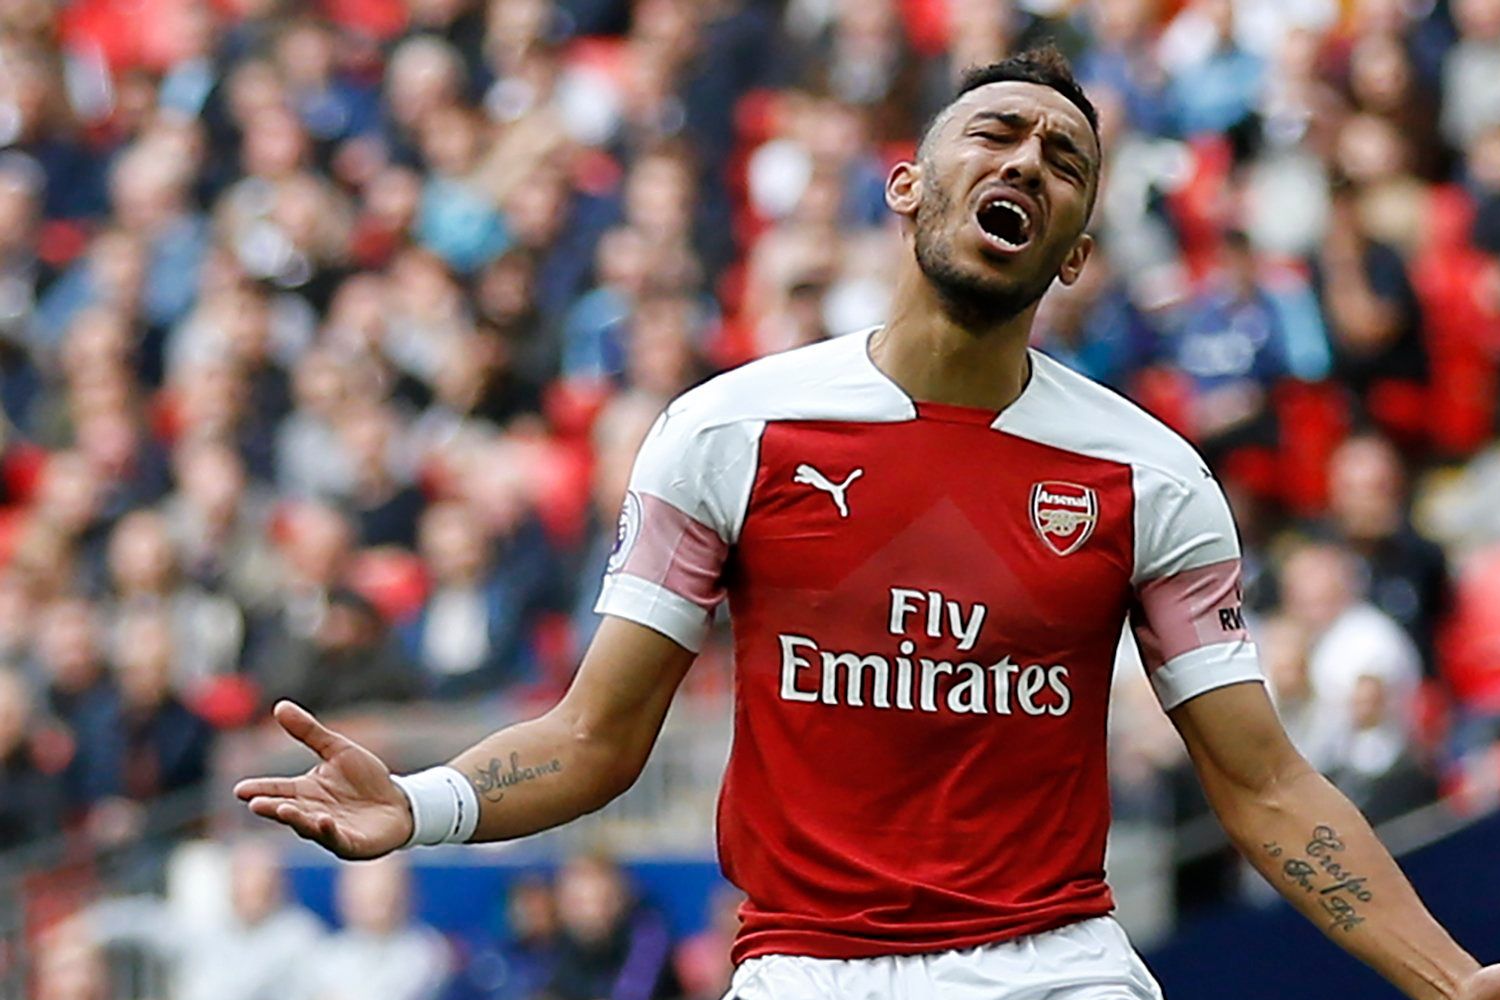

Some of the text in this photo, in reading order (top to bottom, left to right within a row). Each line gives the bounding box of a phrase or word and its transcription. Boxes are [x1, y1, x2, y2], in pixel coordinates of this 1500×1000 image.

[1038, 490, 1088, 508] Arsenal
[889, 587, 986, 650] Fly
[778, 634, 1072, 716] Emirates
